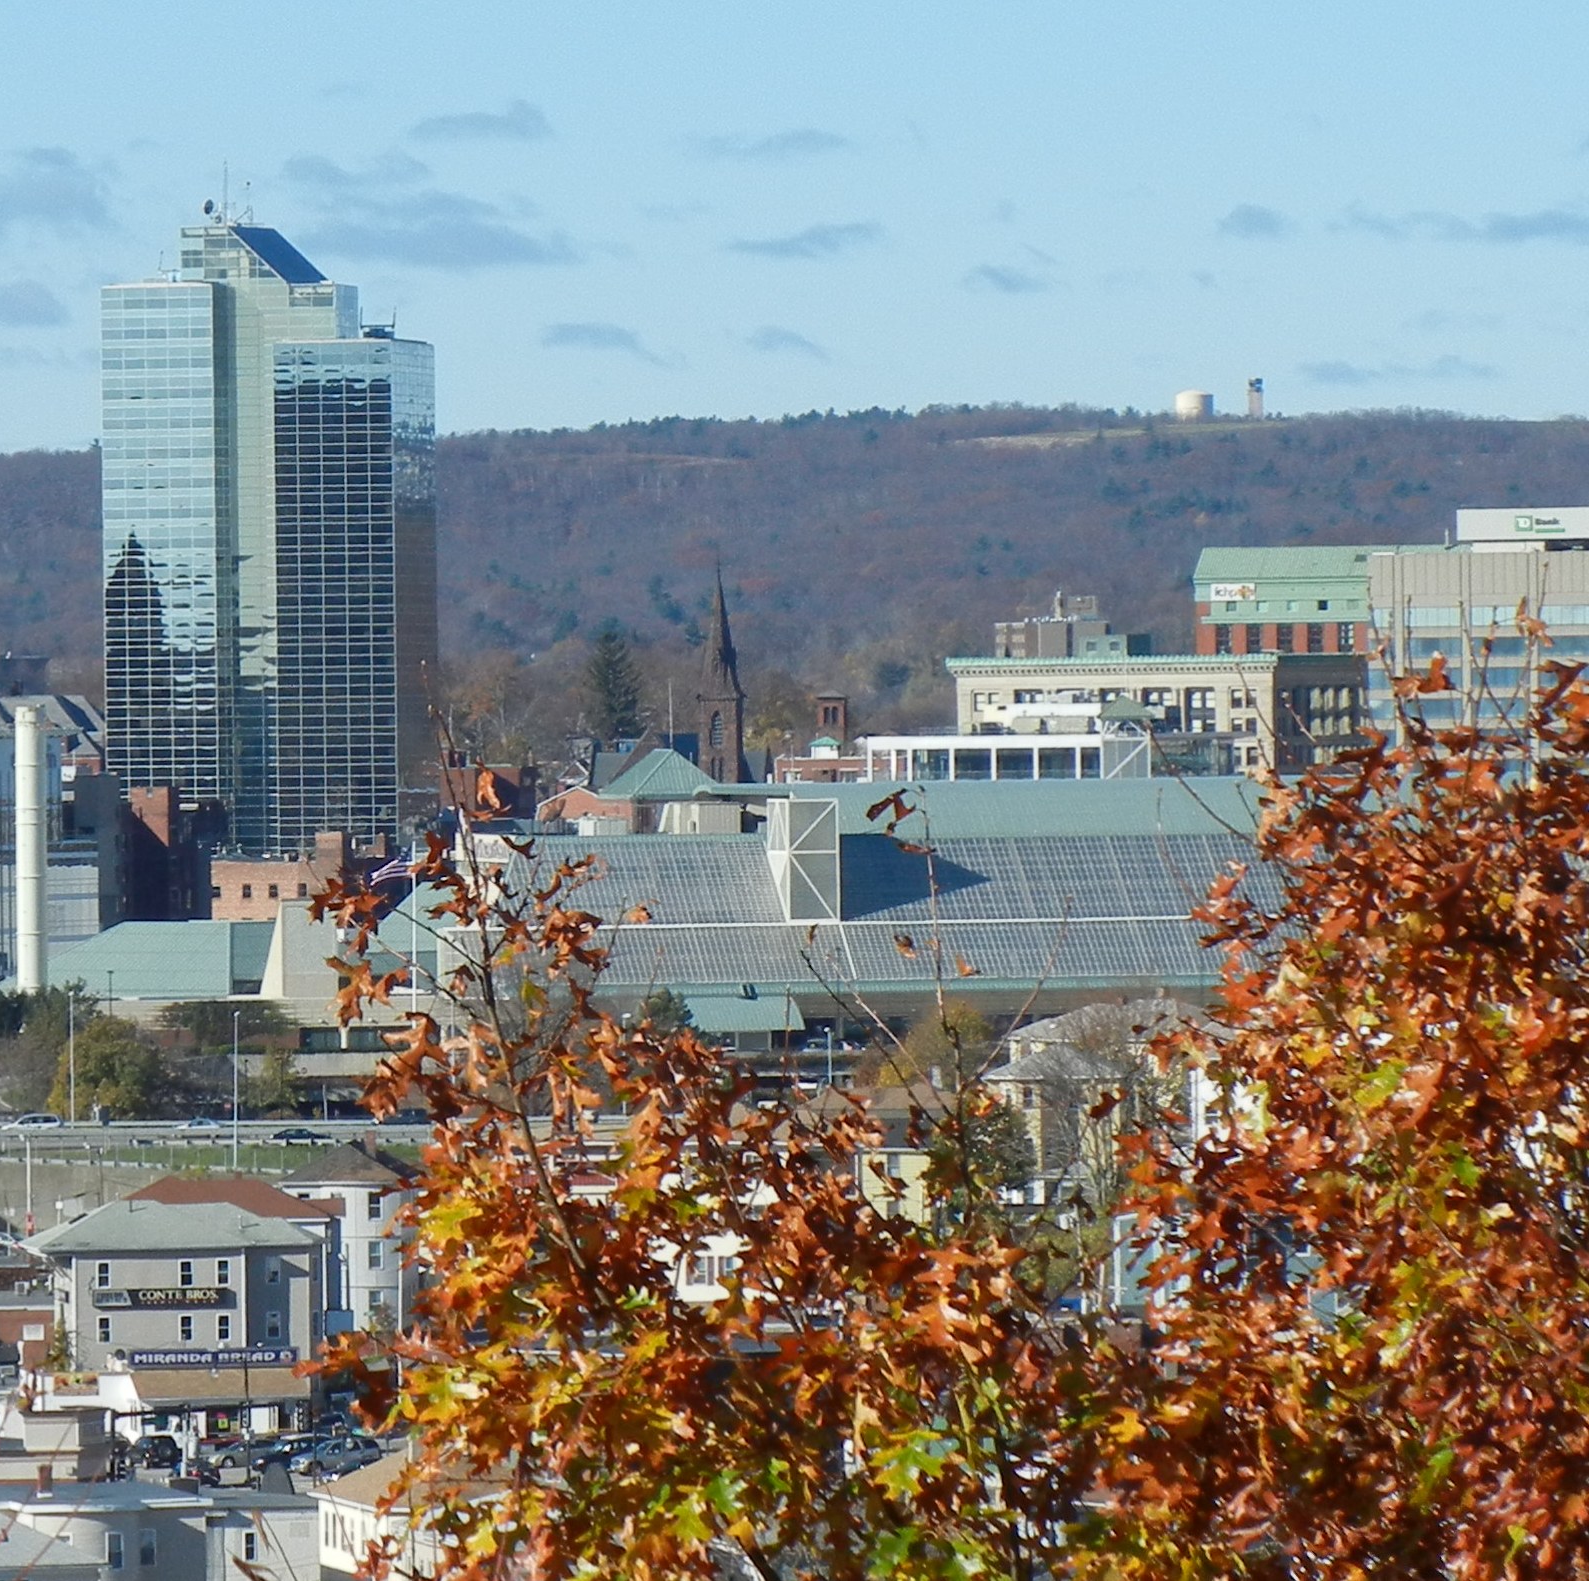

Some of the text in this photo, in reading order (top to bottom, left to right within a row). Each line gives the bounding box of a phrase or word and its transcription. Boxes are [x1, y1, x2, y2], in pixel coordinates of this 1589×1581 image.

[1535, 518, 1561, 526] Bank
[138, 1288, 219, 1300] CONTE BROS.
[133, 1351, 276, 1364] MIRANDA BREAD
